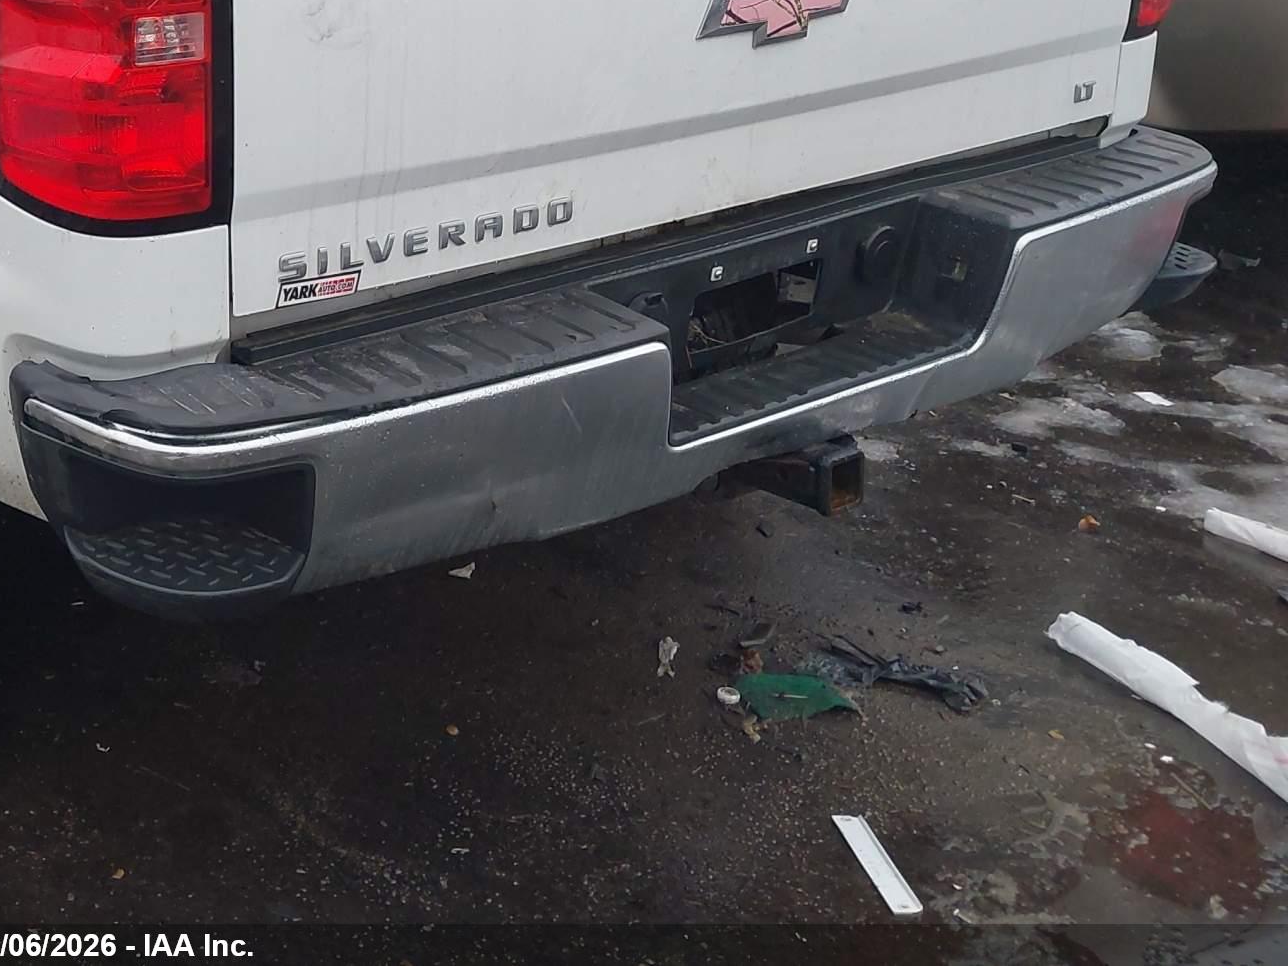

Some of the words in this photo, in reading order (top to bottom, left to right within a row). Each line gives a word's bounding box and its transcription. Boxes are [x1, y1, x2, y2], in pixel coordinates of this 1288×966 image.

[1073, 81, 1096, 103] LT
[278, 197, 573, 282] SILVERADO
[283, 283, 318, 302] YARK
